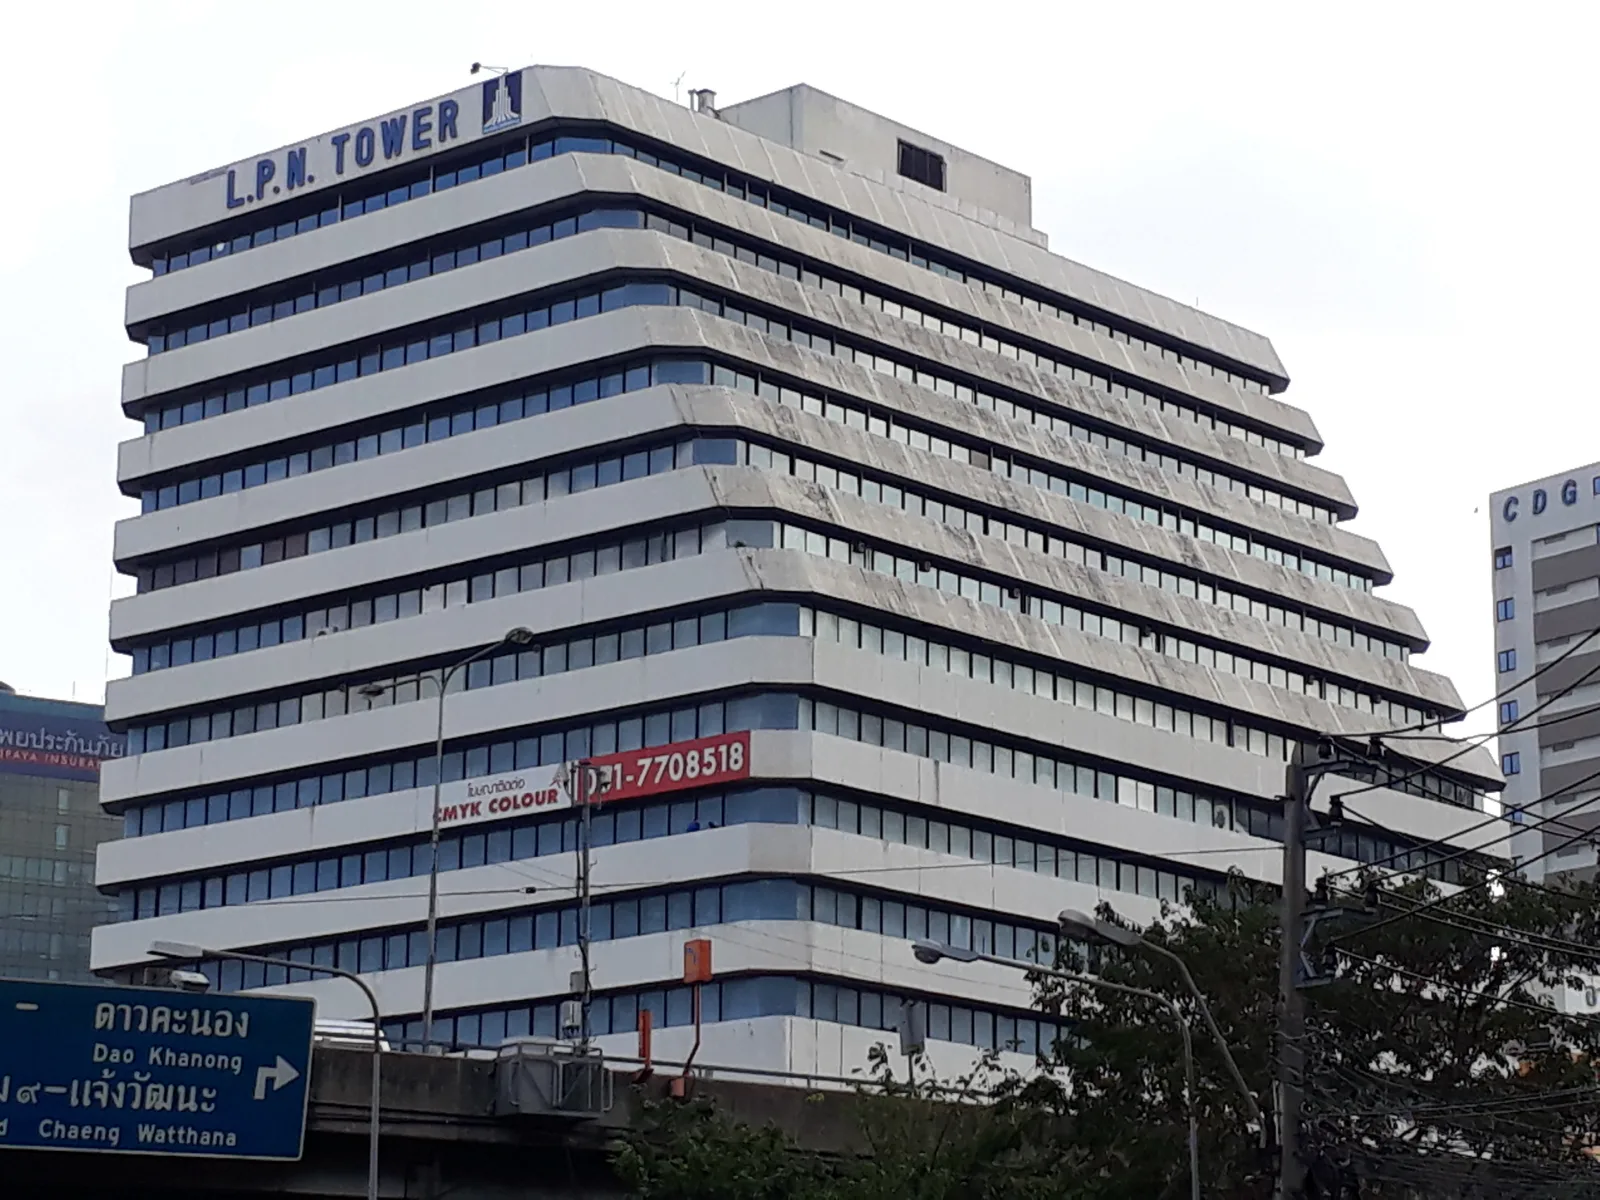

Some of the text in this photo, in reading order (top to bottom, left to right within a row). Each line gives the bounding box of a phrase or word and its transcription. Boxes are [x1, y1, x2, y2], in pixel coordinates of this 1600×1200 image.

[226, 99, 459, 209] L.P.N. TOWER
[1502, 478, 1577, 523] CDG
[488, 788, 559, 814] COLOUR
[94, 1002, 249, 1038] ดาวคะนอง
[92, 1043, 243, 1076] Dao Khanong
[39, 1118, 121, 1147] Chaeng
[138, 1123, 238, 1148] Watthana
